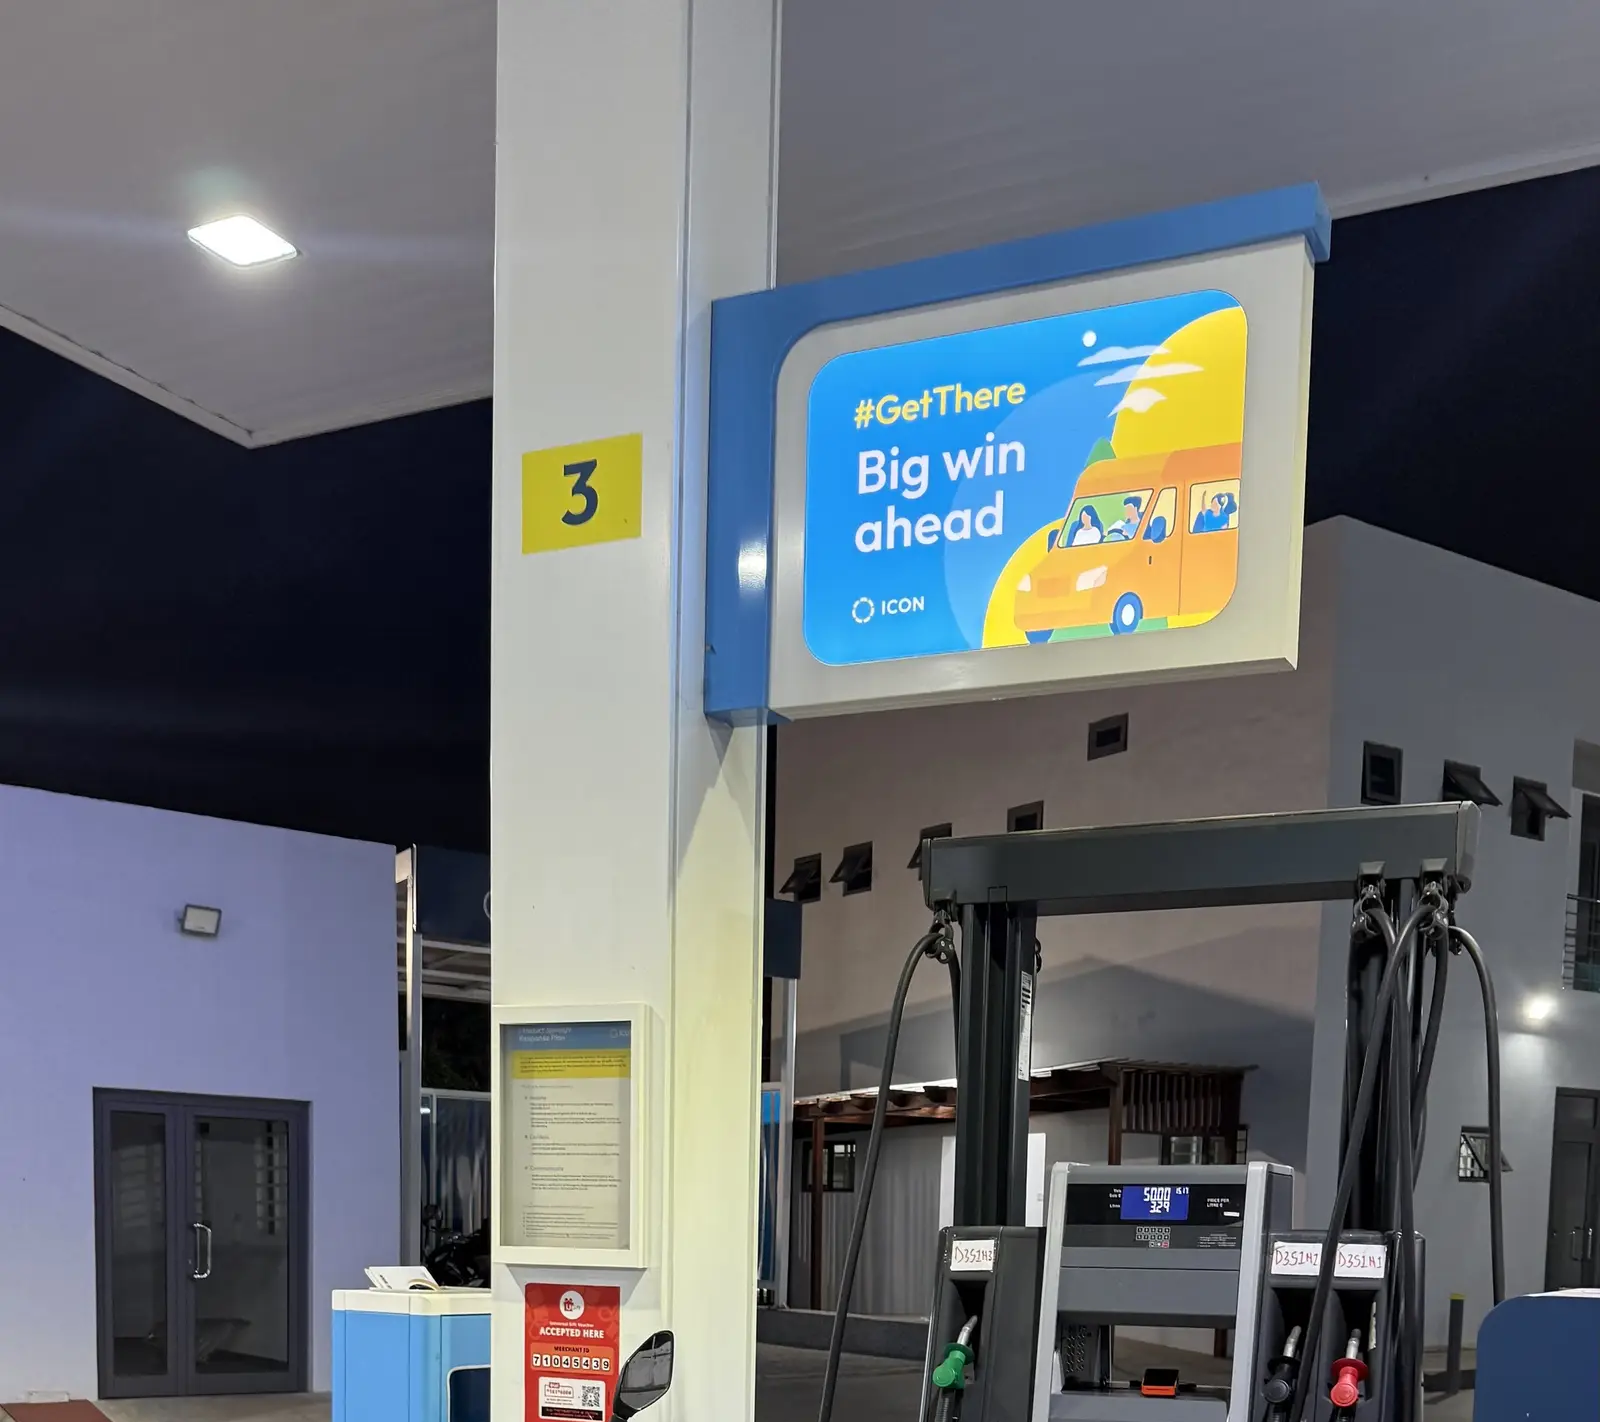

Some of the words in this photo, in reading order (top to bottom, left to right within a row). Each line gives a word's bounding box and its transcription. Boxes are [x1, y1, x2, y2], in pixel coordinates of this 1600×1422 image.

[854, 380, 1026, 429] #GetThere
[560, 458, 599, 526] 3
[857, 448, 930, 500] Big
[943, 431, 1026, 479] win
[854, 491, 1005, 554] ahead
[880, 595, 925, 616] ICON
[539, 1327, 581, 1338] ACCEPTED
[583, 1329, 605, 1339] HERE
